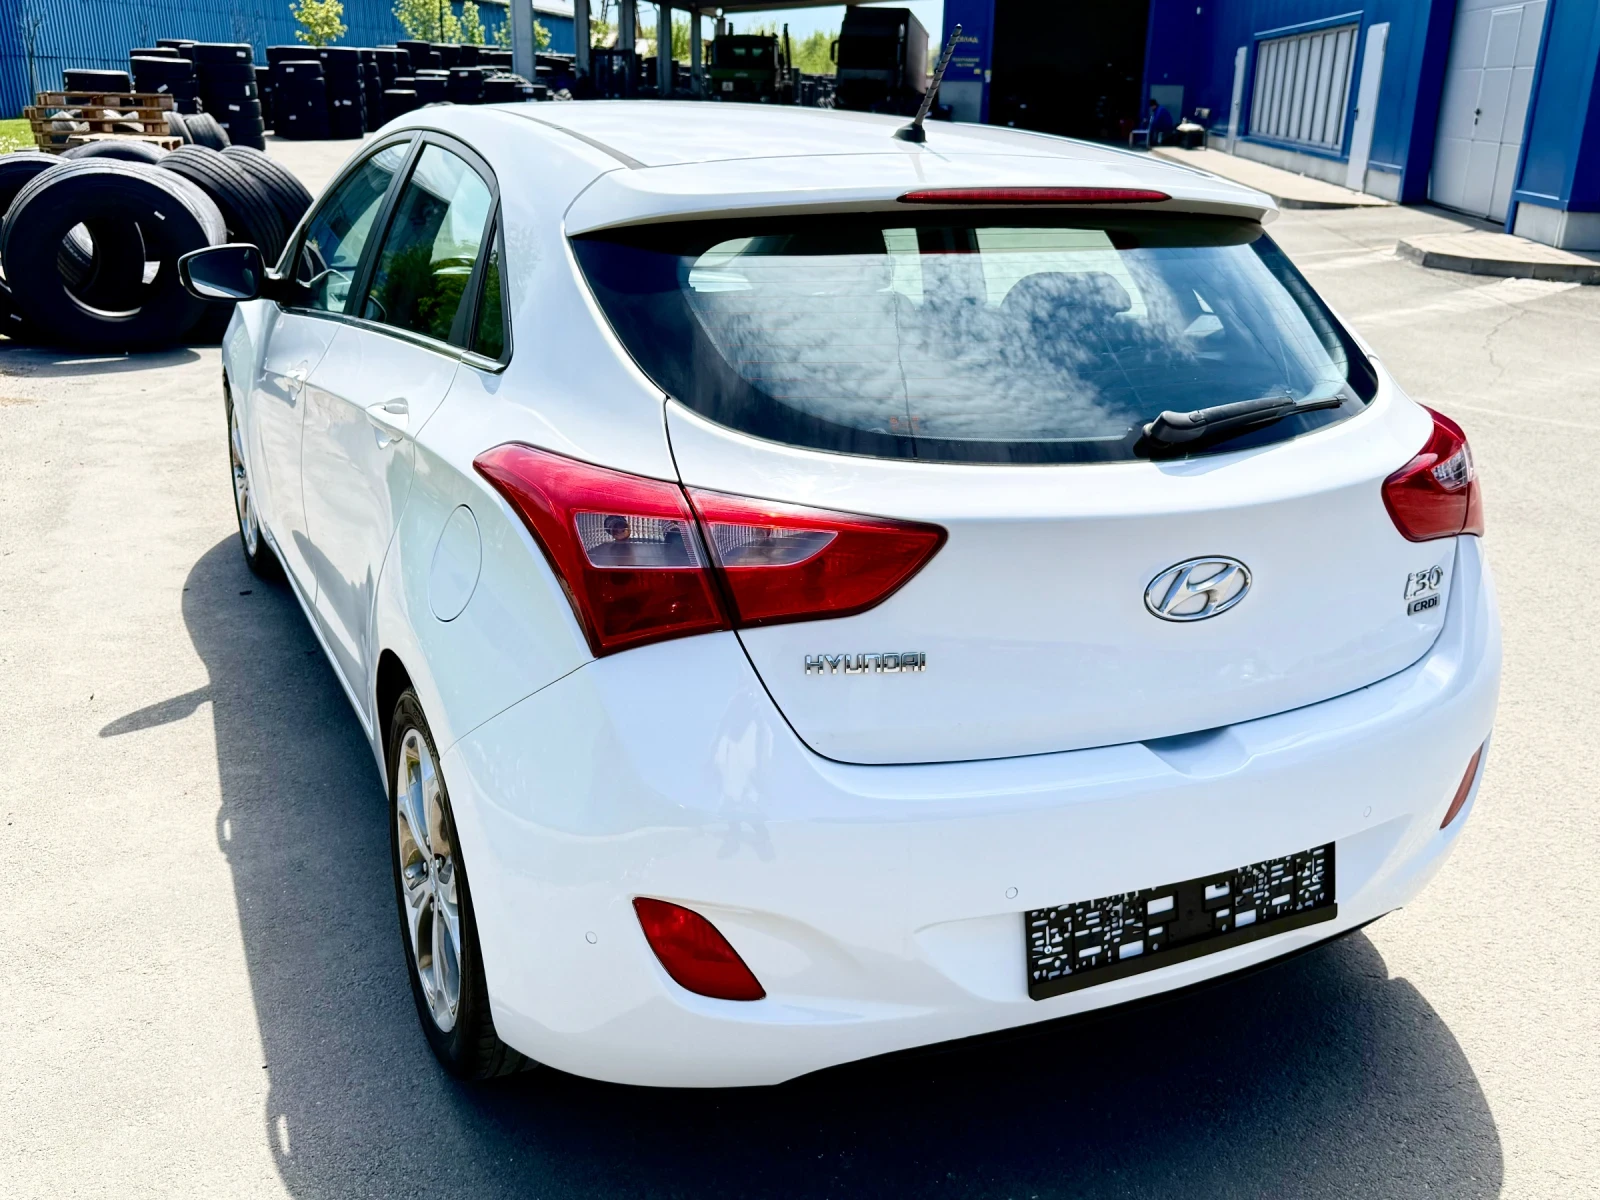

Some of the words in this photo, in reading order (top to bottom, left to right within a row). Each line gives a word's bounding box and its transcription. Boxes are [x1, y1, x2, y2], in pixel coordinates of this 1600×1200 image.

[1404, 565, 1443, 600] i30
[1413, 596, 1438, 613] CRDi
[805, 651, 927, 675] HYUNDAI
